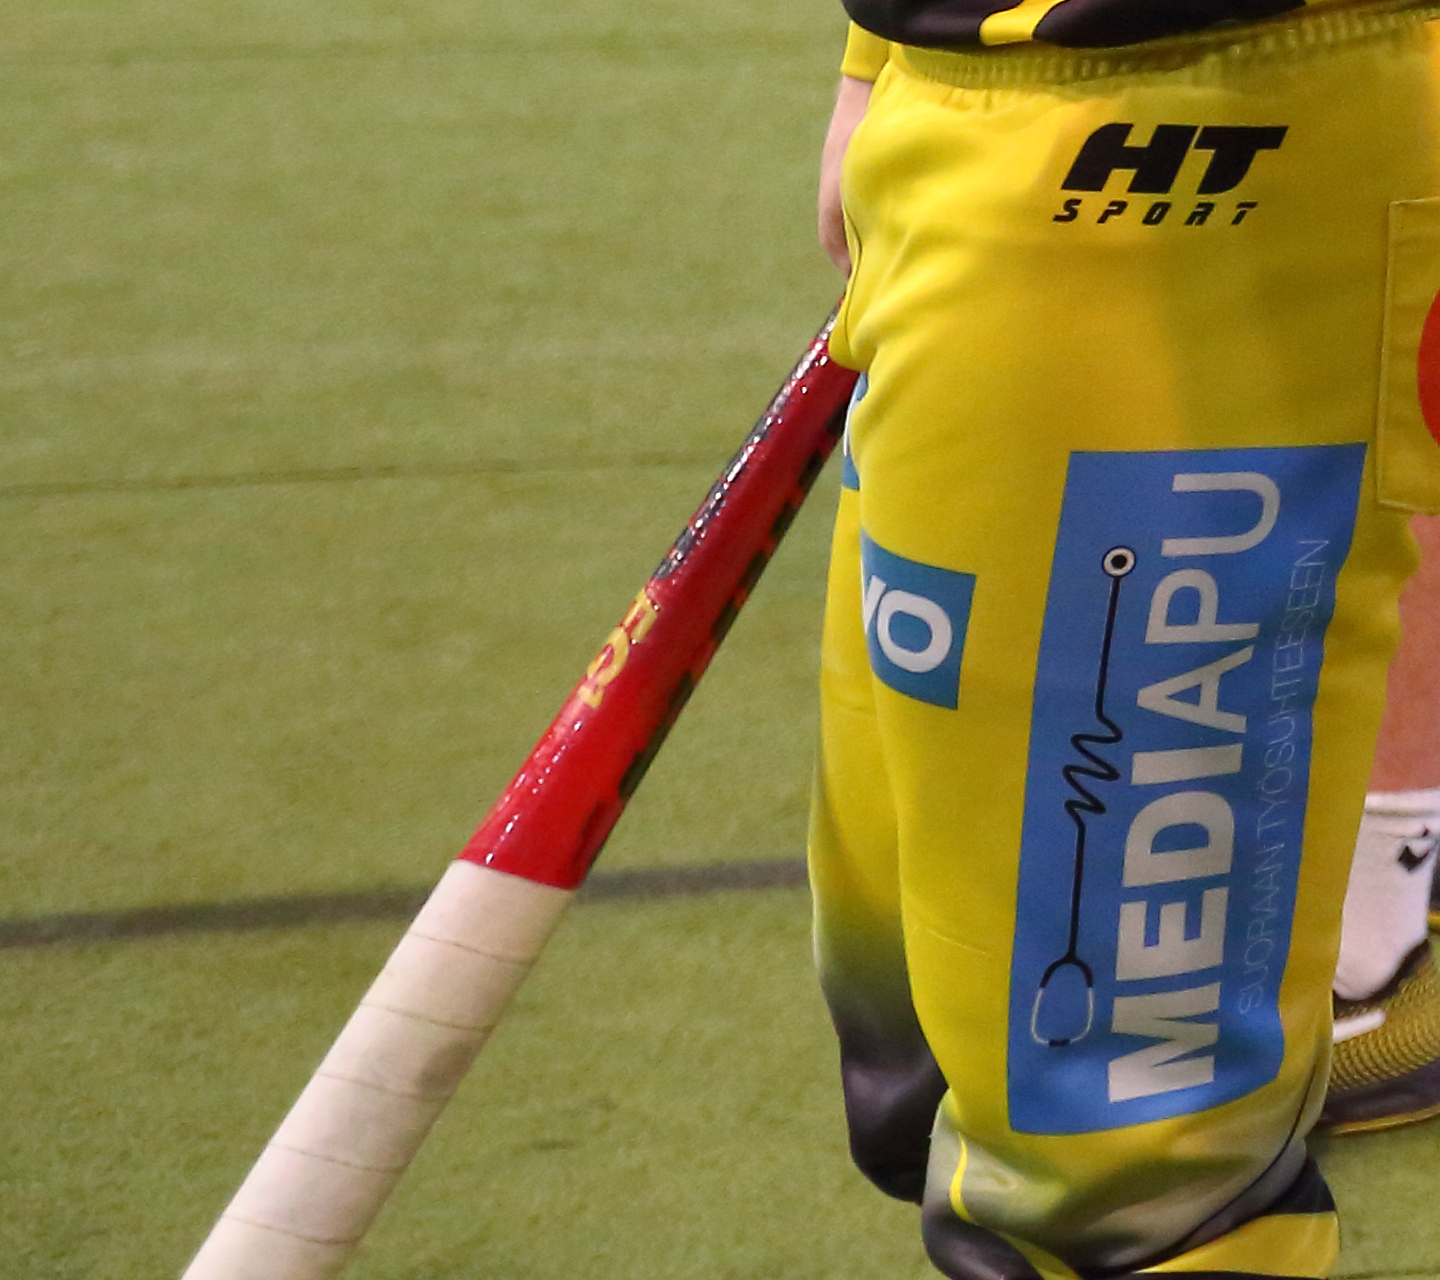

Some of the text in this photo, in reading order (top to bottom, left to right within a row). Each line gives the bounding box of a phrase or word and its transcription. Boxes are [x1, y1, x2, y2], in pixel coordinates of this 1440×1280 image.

[1052, 198, 1259, 226] SPORT
[1061, 122, 1290, 195] HT
[1107, 470, 1282, 1104] MEDIAPU
[1237, 842, 1286, 1015] SUORAAN
